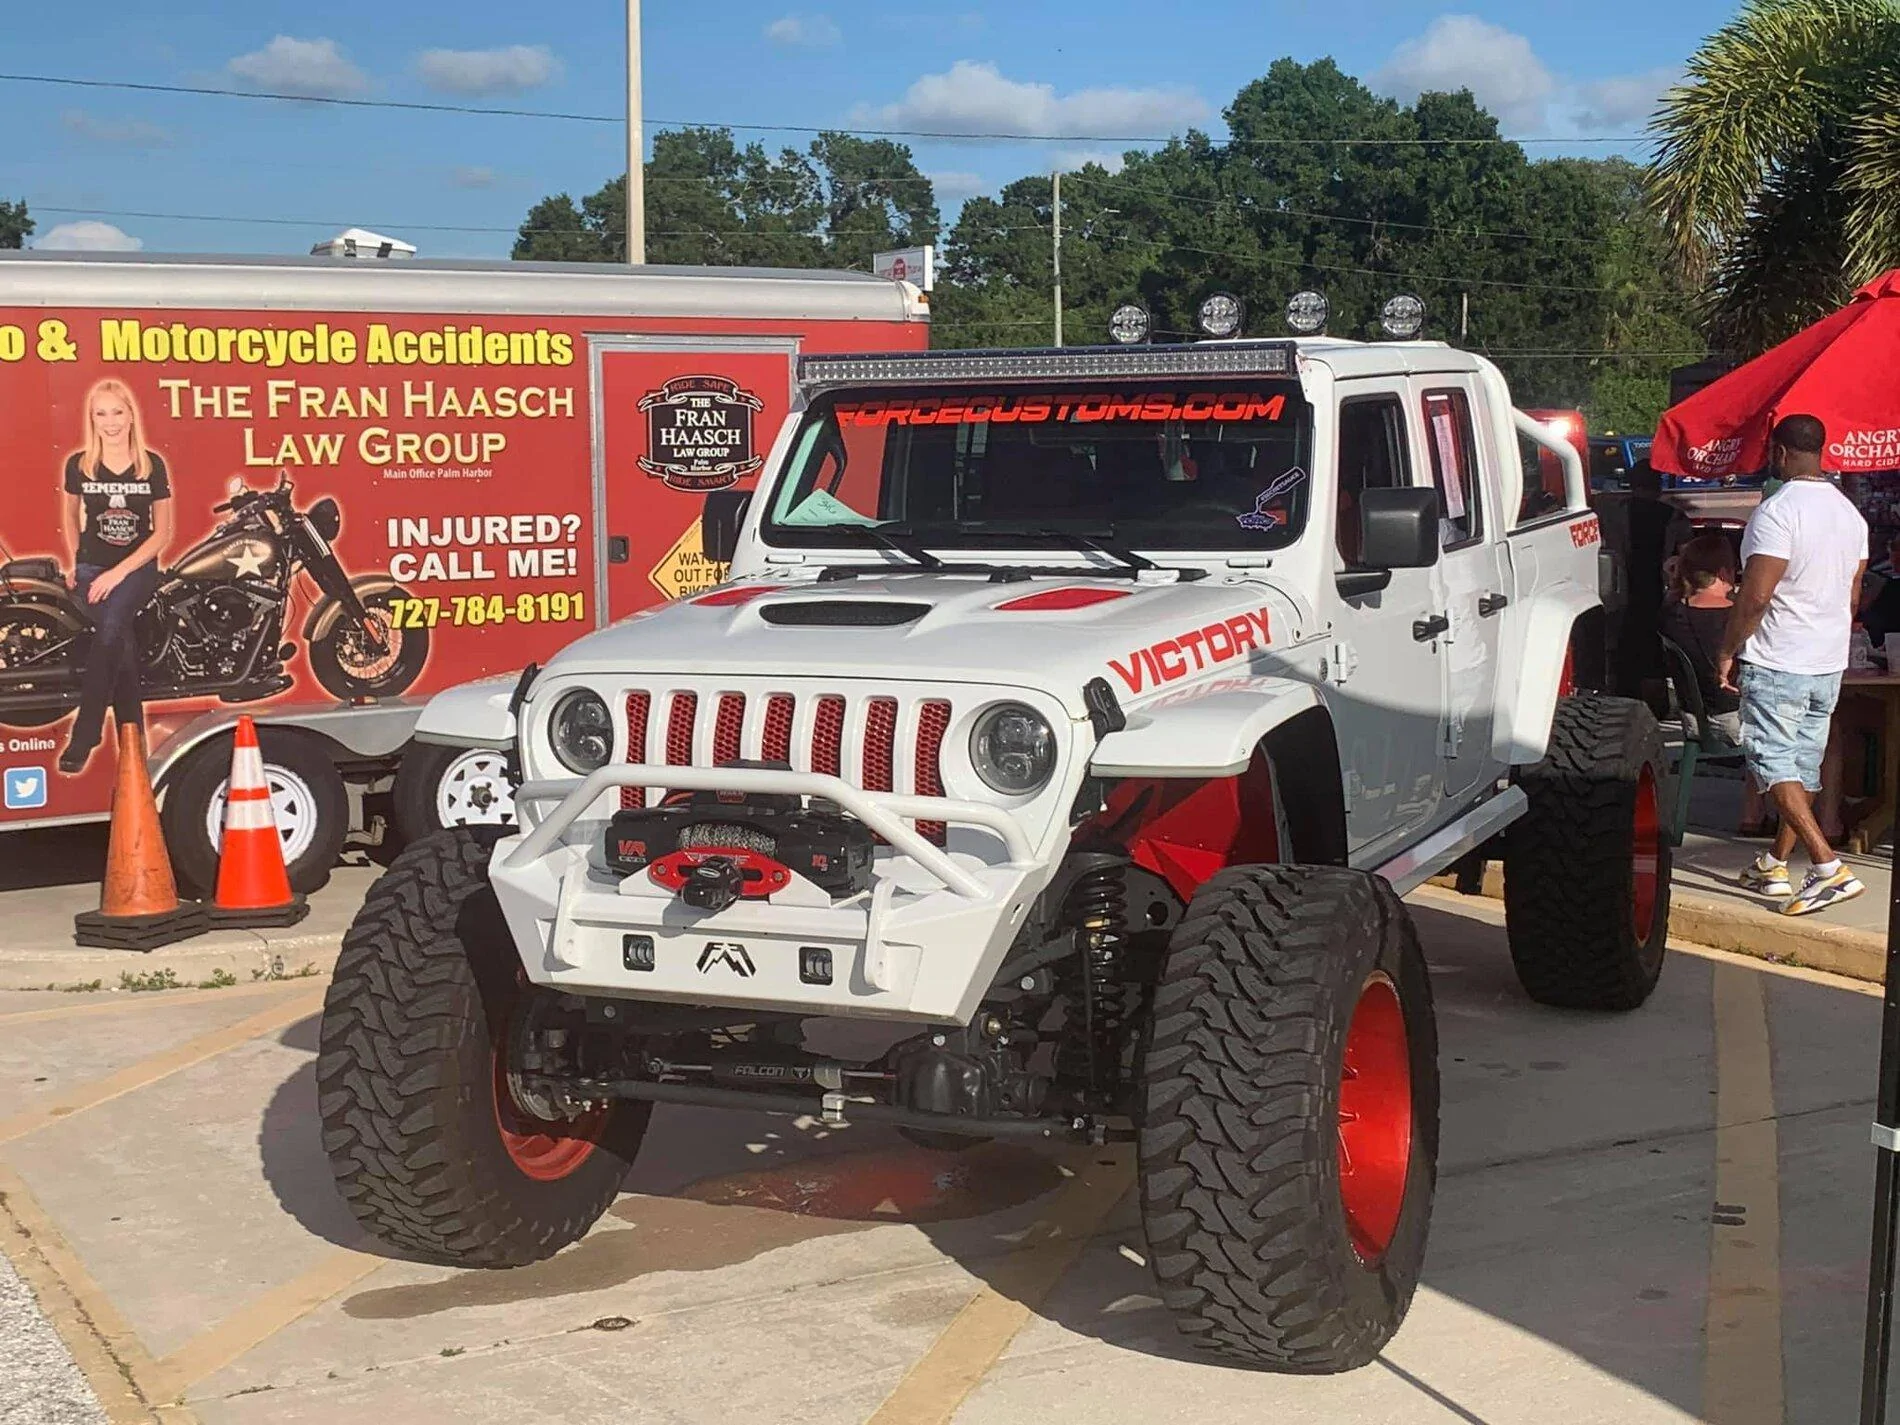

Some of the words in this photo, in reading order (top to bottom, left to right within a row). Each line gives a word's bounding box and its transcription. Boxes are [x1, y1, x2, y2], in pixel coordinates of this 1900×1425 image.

[37, 319, 77, 362] &
[100, 319, 357, 367] Motorcycle
[366, 323, 574, 366] Accidents
[669, 380, 695, 392] RIDE
[158, 378, 253, 418] THE
[267, 379, 389, 418] FRAN
[403, 380, 574, 418] HAASCH
[690, 398, 711, 408] THE
[674, 409, 727, 427] FRAN
[834, 393, 1285, 426] FORCECUSTOMS.COM
[660, 427, 741, 446] HAASCH
[244, 427, 345, 466] LAW
[358, 427, 506, 465] GROUP
[673, 447, 695, 458] LAW
[696, 447, 730, 458] GROUP
[1842, 459, 1872, 467] HARD
[383, 468, 407, 479] Main
[409, 467, 435, 479] Office
[437, 467, 460, 478] Palm
[462, 467, 493, 478] Harbor
[387, 514, 581, 548] INJURED?
[389, 551, 496, 583] CALL
[508, 548, 578, 578] ME!
[674, 570, 701, 583] OUT
[389, 592, 585, 630] 727-784-8191
[1107, 606, 1272, 695] VICTORY
[9, 737, 56, 752] Online
[734, 1065, 785, 1077] FALCON
